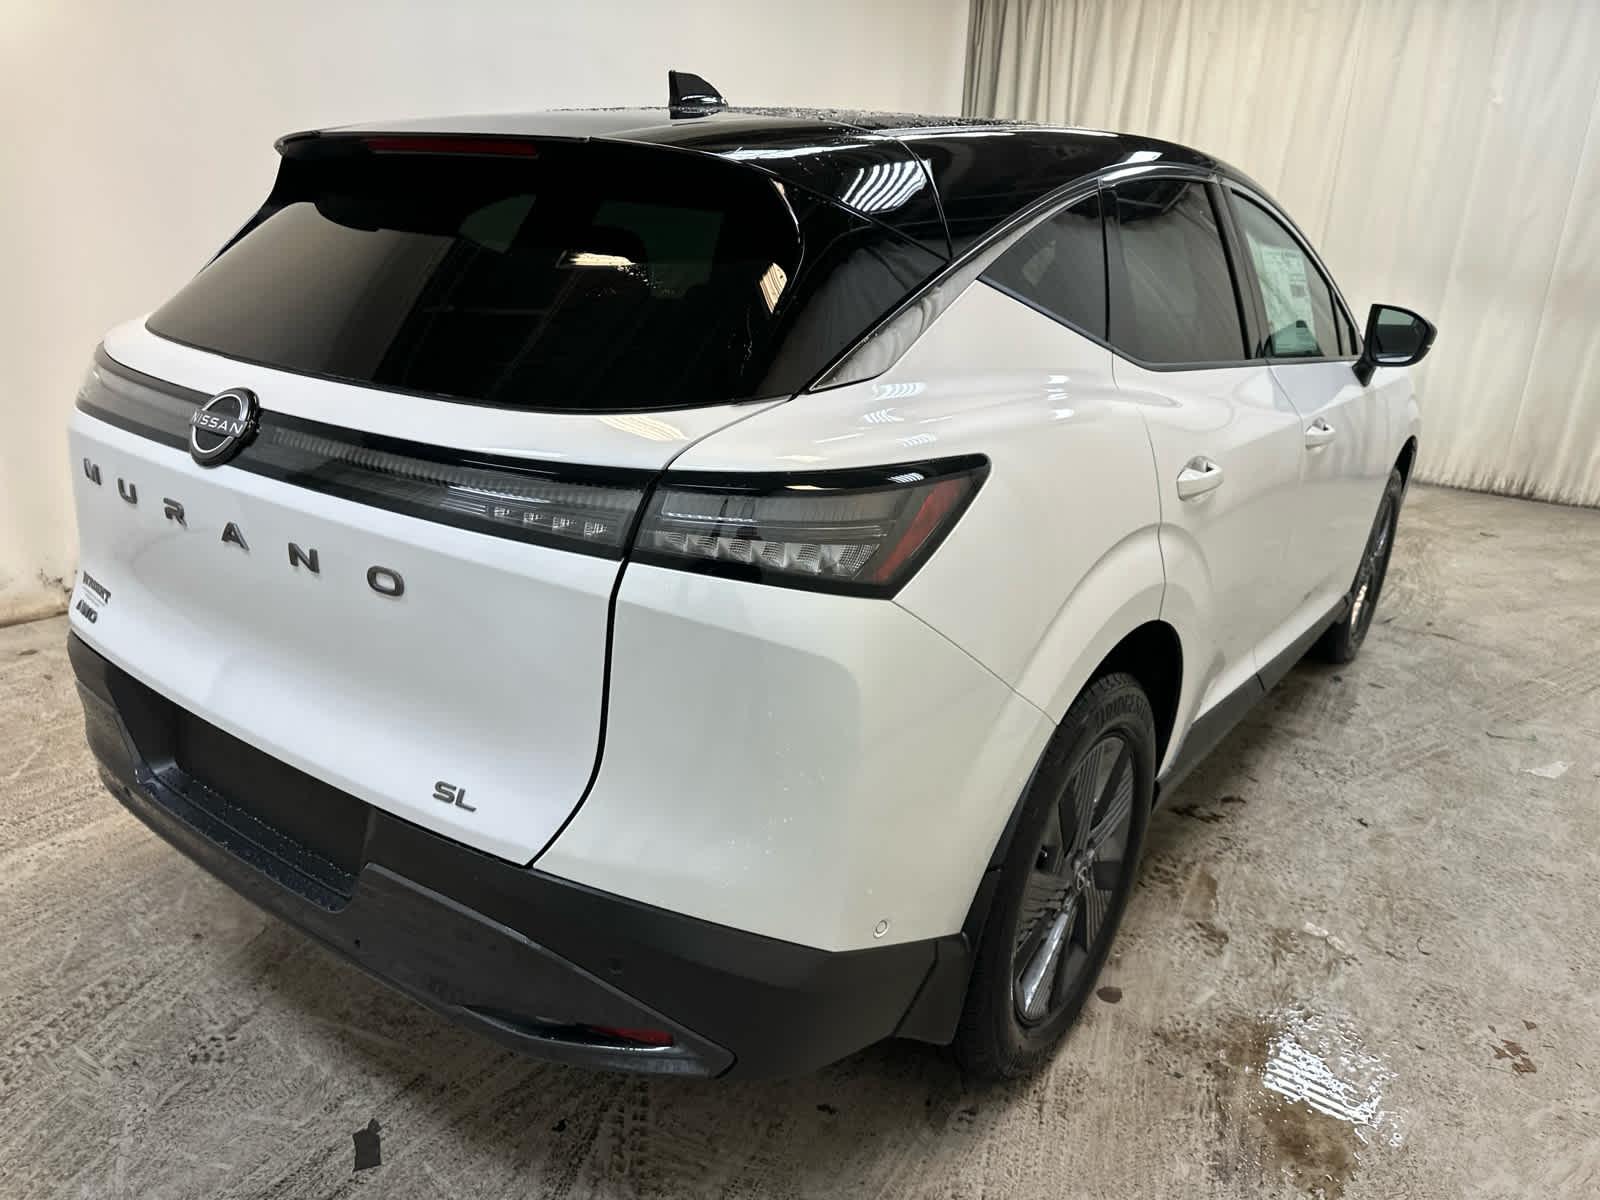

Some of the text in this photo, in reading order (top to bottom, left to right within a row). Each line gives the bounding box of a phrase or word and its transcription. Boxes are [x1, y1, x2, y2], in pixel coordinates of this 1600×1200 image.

[192, 410, 244, 434] NISSAN
[83, 457, 405, 597] MURANO
[432, 781, 477, 813] SL
